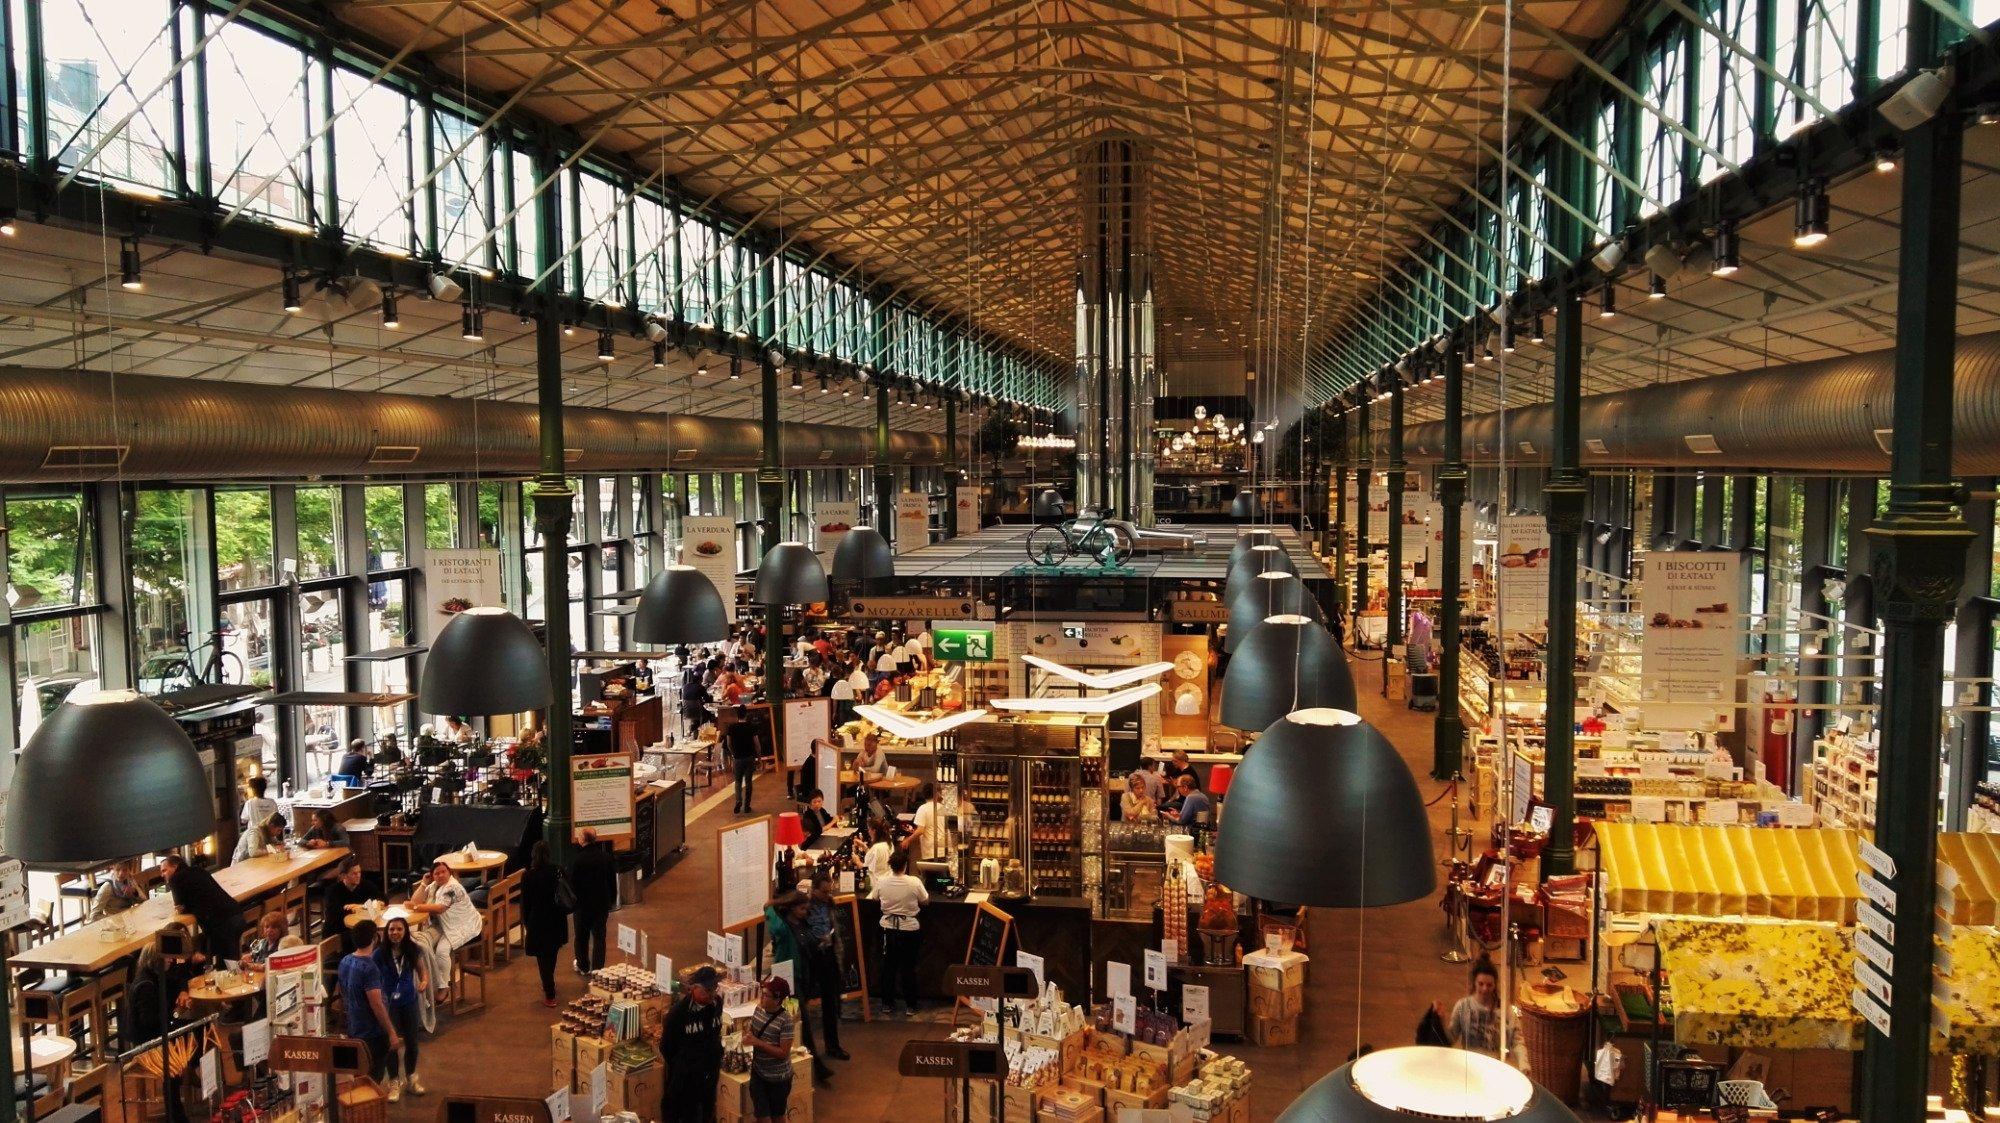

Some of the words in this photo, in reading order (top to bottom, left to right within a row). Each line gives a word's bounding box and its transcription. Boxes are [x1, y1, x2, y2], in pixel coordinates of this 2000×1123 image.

[697, 526, 731, 534] VERDURA
[439, 558, 492, 567] RISTORANTI
[1657, 561, 1662, 571] I
[1666, 561, 1726, 571] BISCOTTI
[1667, 572, 1678, 580] DI
[1680, 572, 1716, 580] EATALY
[867, 607, 960, 617] MOZZARELLE
[956, 976, 990, 986] KASSEN
[283, 1049, 319, 1061] KASSEN
[915, 1055, 954, 1066] KASSEN
[493, 1112, 535, 1123] KASSEN
